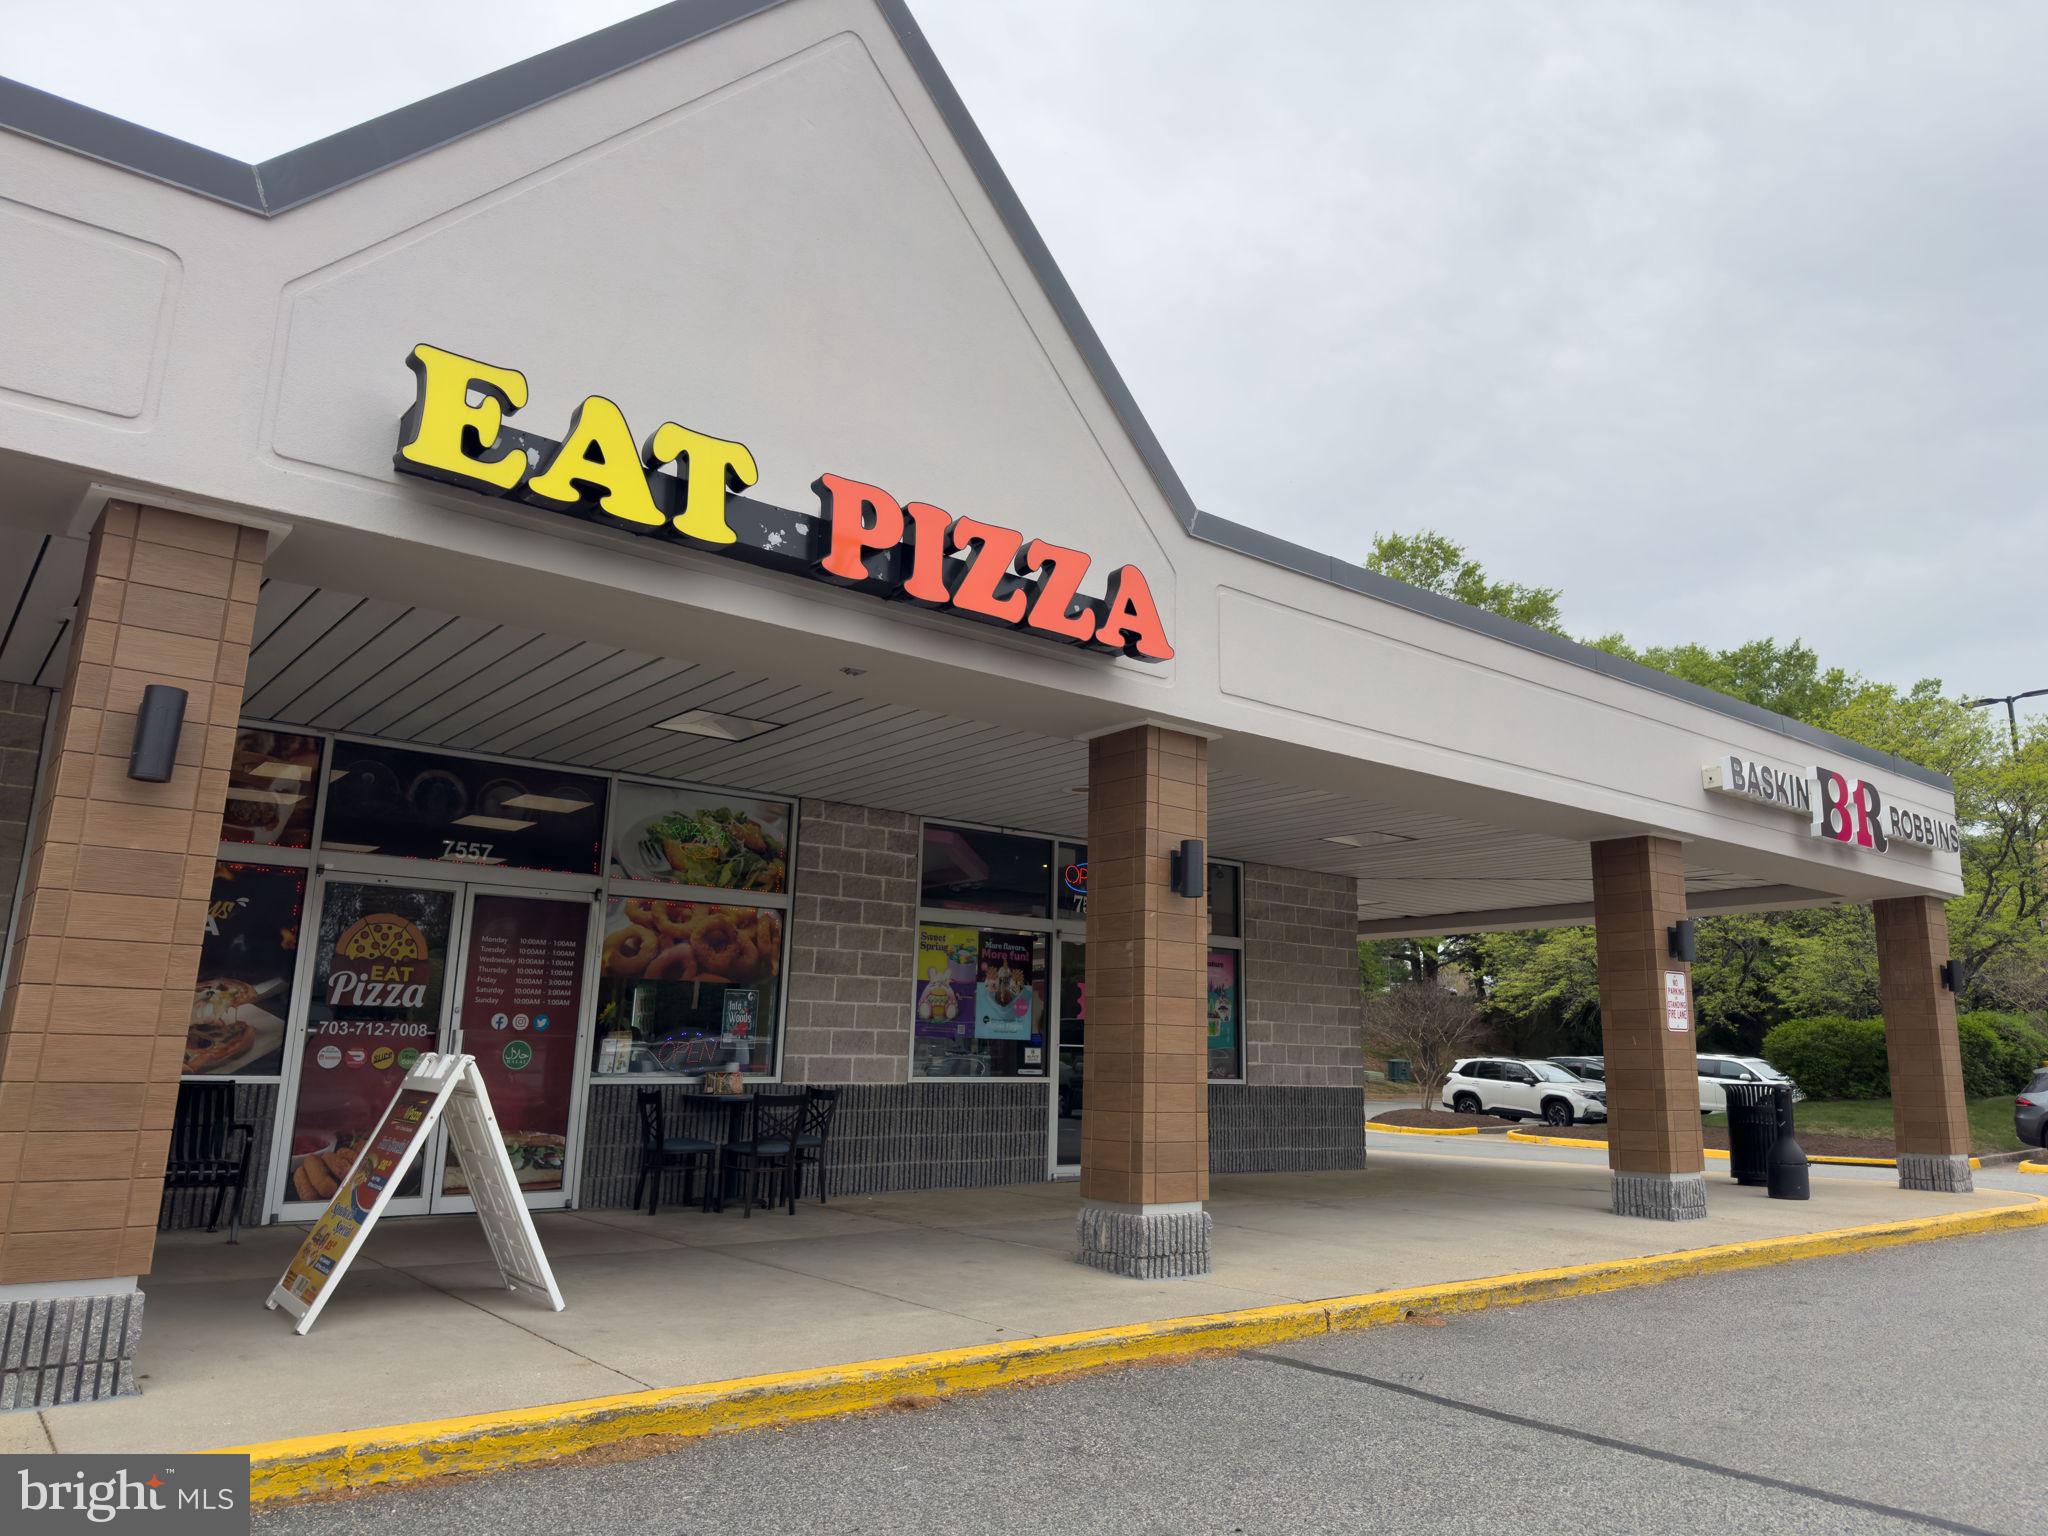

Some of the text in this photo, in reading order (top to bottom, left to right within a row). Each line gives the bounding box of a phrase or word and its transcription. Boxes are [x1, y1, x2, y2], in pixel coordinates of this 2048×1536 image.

[400, 344, 1175, 661] EAT PIZZA
[1730, 756, 1810, 811] BASKIN
[1890, 805, 1960, 853] ROBBINS
[442, 840, 494, 860] 7557
[481, 936, 508, 944] Monday
[920, 932, 946, 943] Sweet
[480, 946, 506, 954] Tuesday
[981, 949, 1030, 962] More fun!
[479, 956, 516, 965] Wednesday
[371, 965, 414, 982] EAT
[478, 966, 508, 974] Thursday
[477, 976, 497, 984] Friday
[328, 970, 427, 1008] Pizza
[476, 986, 504, 995] Saturday
[474, 996, 499, 1005] Sunday
[728, 1012, 751, 1024] Woods
[319, 1021, 428, 1037] 703-712-7008
[657, 1041, 719, 1064] OPEN
